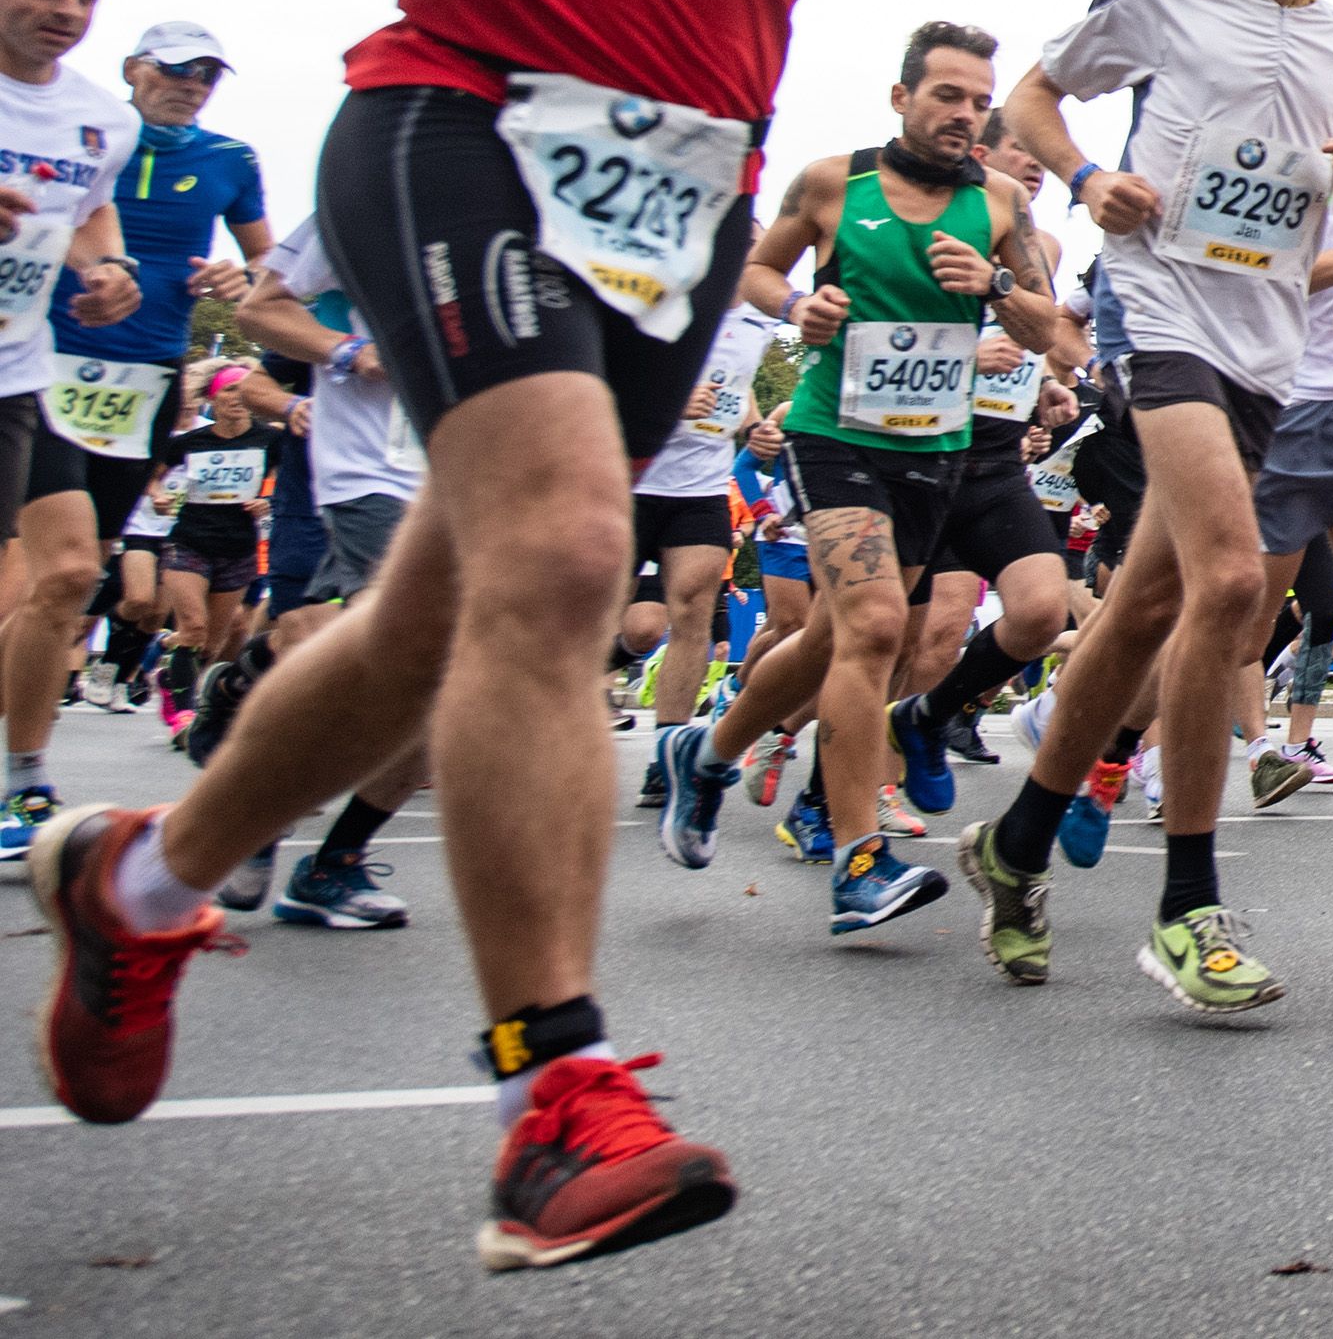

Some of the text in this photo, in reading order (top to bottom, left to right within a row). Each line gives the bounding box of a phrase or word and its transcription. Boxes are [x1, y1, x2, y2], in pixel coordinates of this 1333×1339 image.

[1197, 171, 1311, 229] 32293
[1234, 223, 1262, 240] Jan
[1211, 247, 1250, 263] Giti
[866, 359, 963, 392] 54050
[60, 387, 138, 421] 3154
[886, 417, 920, 427] Giti
[200, 467, 254, 484] 34750
